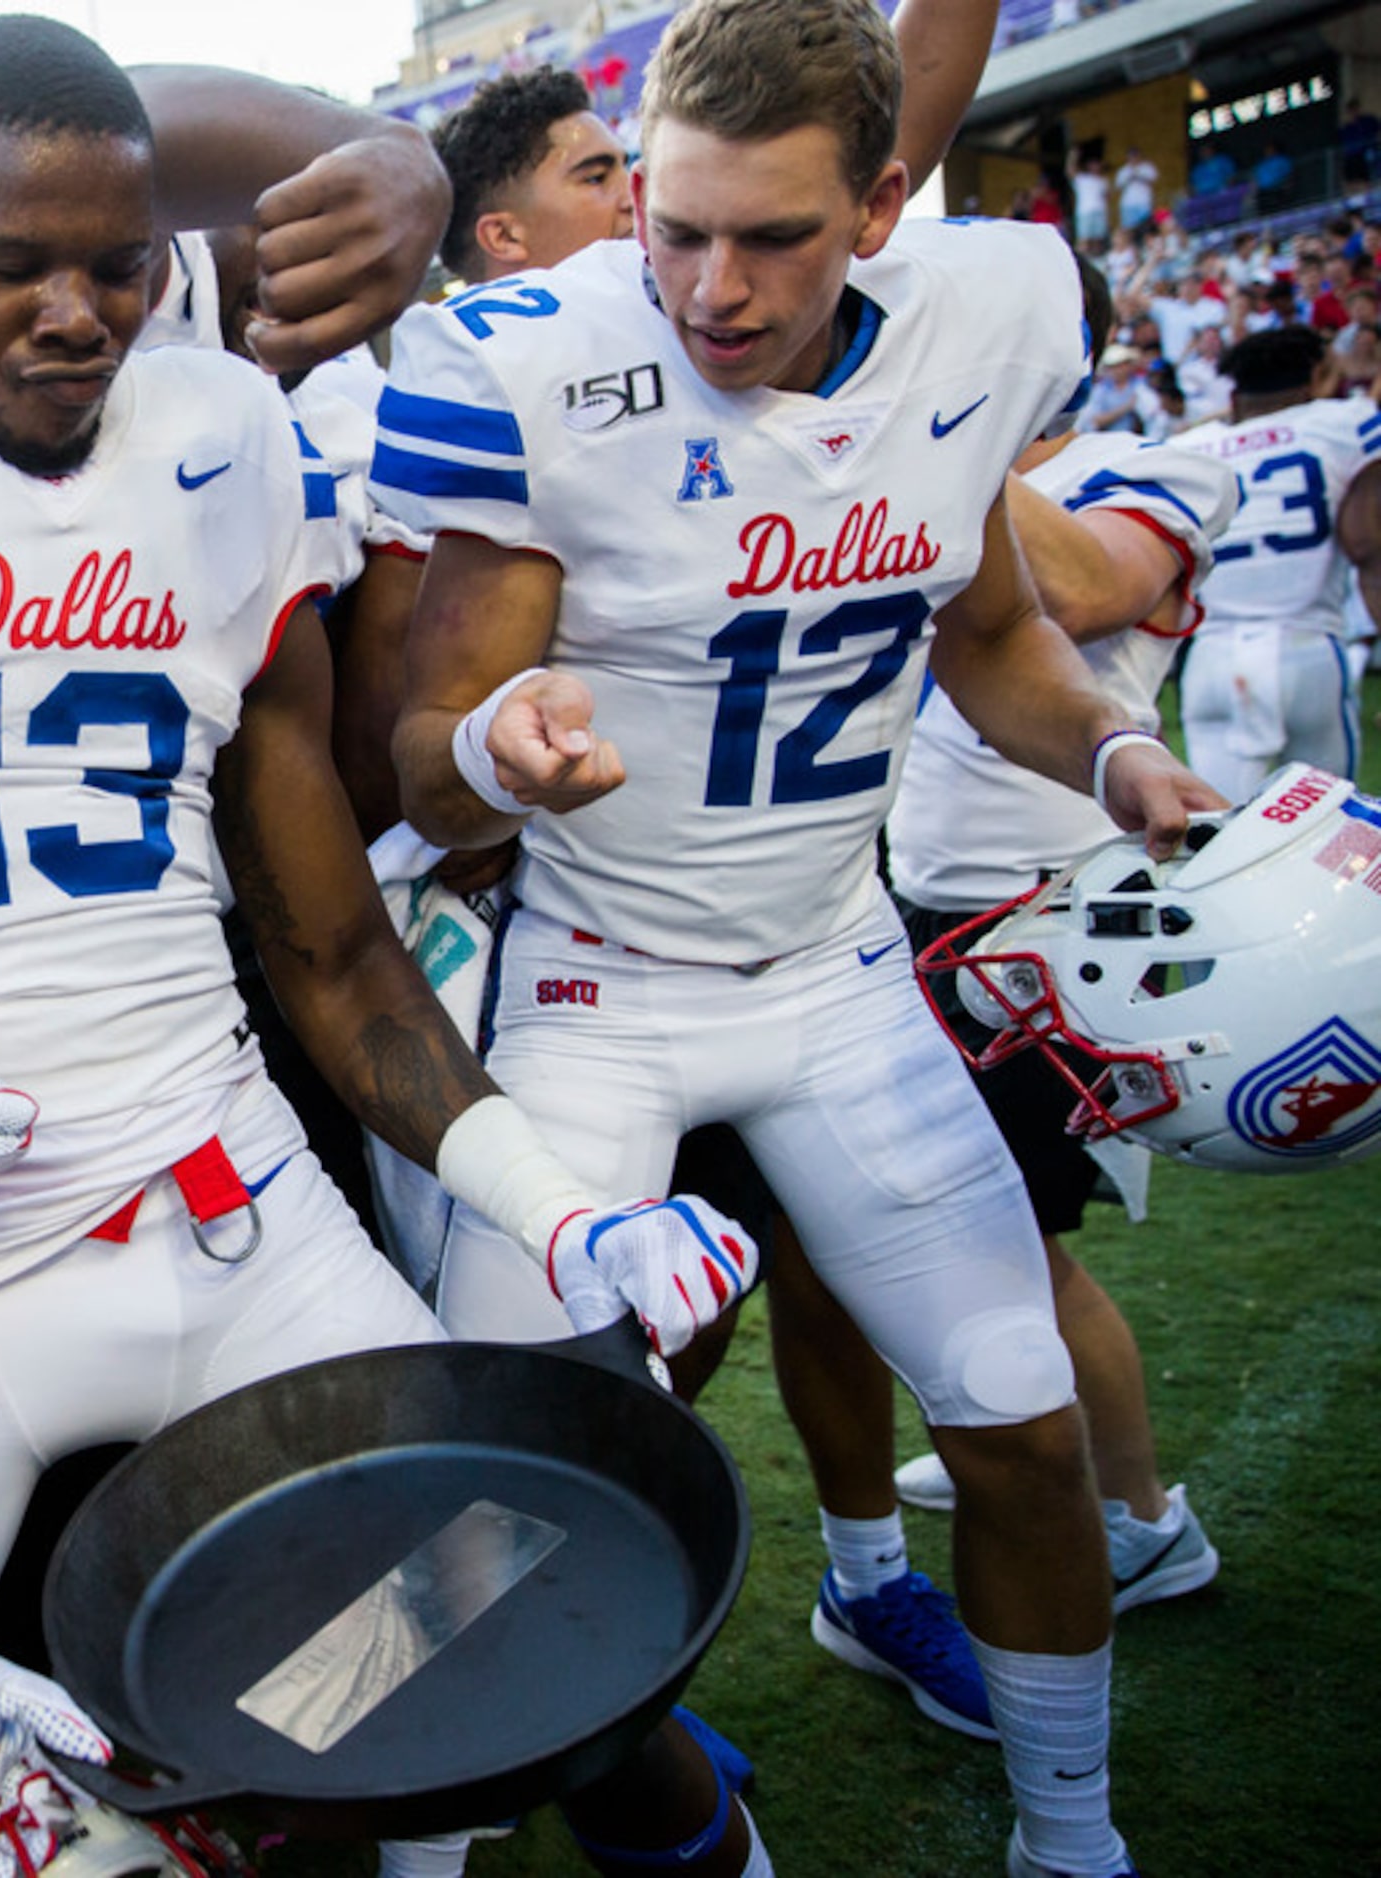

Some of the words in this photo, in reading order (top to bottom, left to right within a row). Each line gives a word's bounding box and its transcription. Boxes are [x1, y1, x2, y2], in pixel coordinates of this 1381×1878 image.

[1188, 74, 1333, 139] SEWELL
[564, 361, 665, 431] 150
[726, 497, 941, 599] Dallas
[1212, 450, 1331, 565] 3
[704, 589, 932, 807] 12
[535, 978, 601, 1009] SMU
